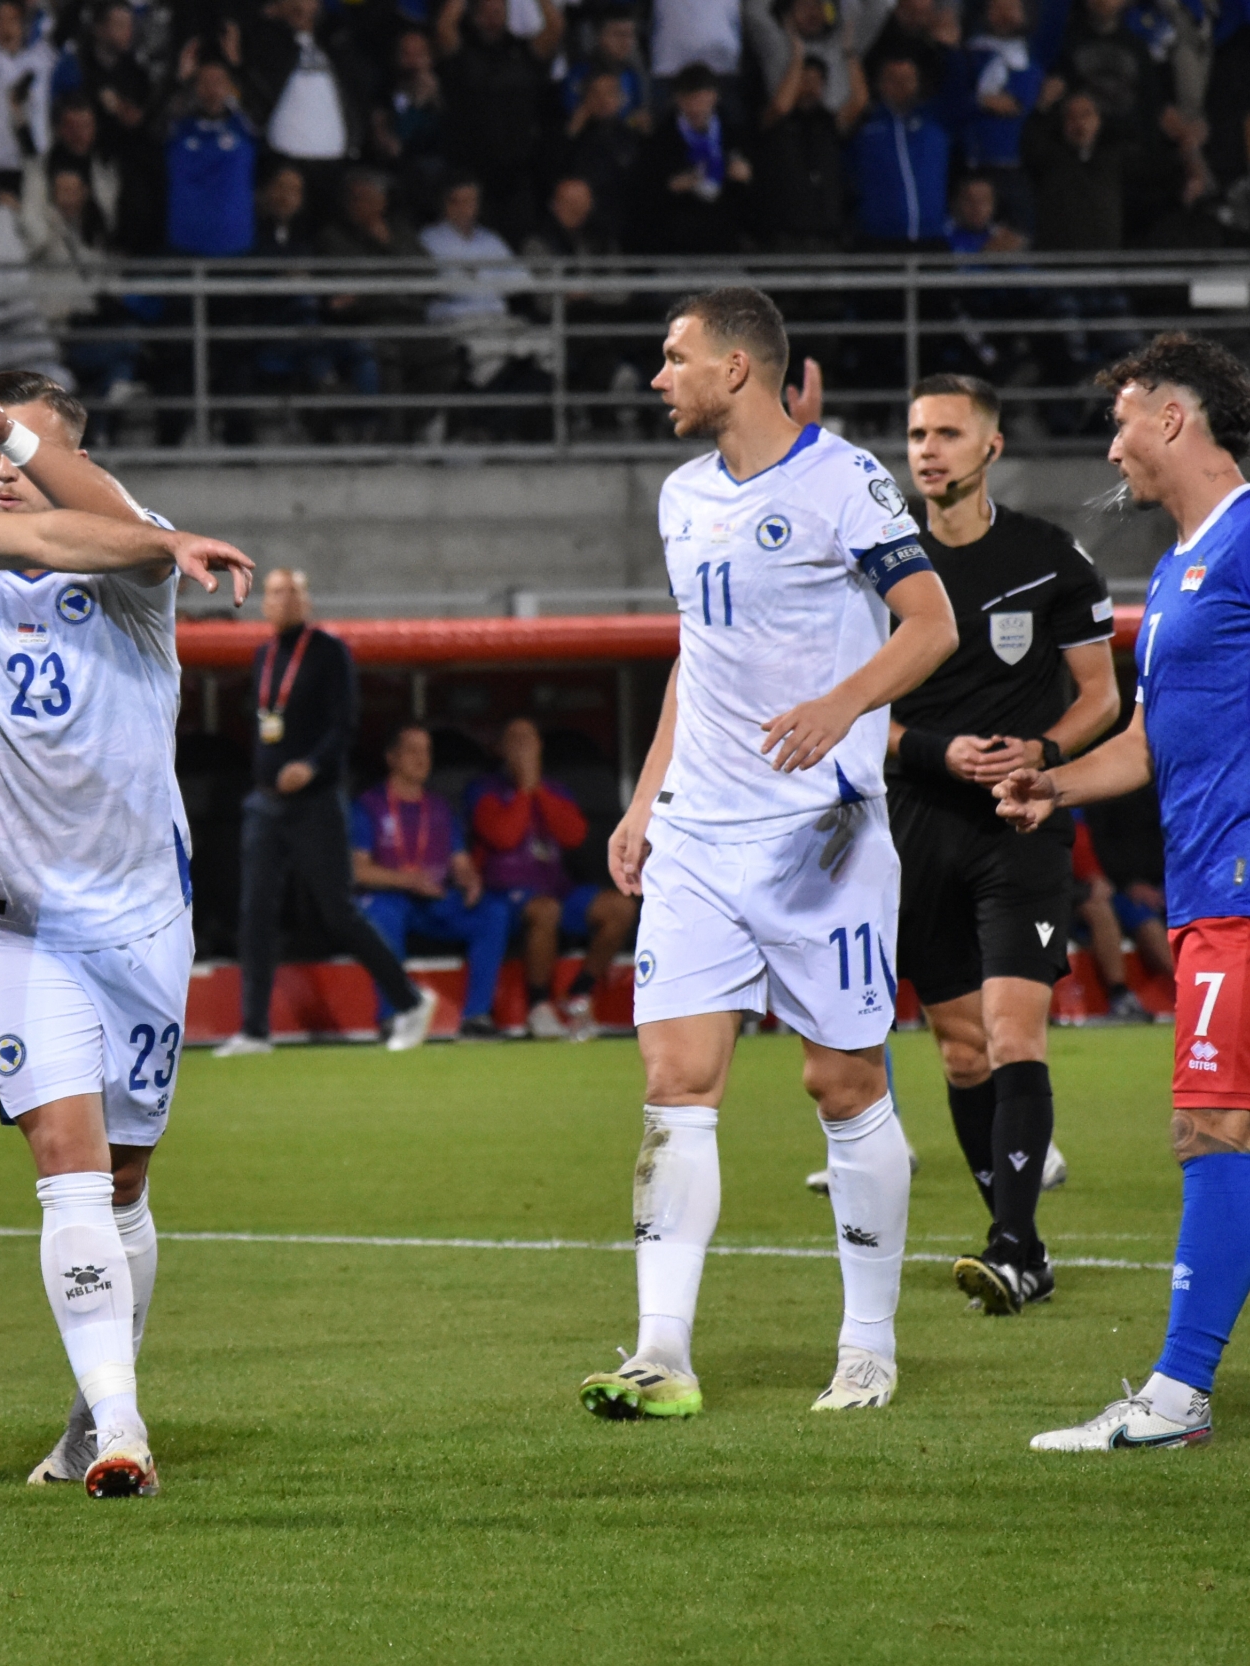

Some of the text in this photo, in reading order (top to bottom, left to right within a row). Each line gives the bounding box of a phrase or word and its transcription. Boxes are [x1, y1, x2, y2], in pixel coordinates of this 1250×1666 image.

[695, 561, 733, 627] 11
[6, 651, 72, 719] 23
[828, 921, 873, 991] 11
[1193, 971, 1227, 1037] 7
[128, 1022, 180, 1092] 23
